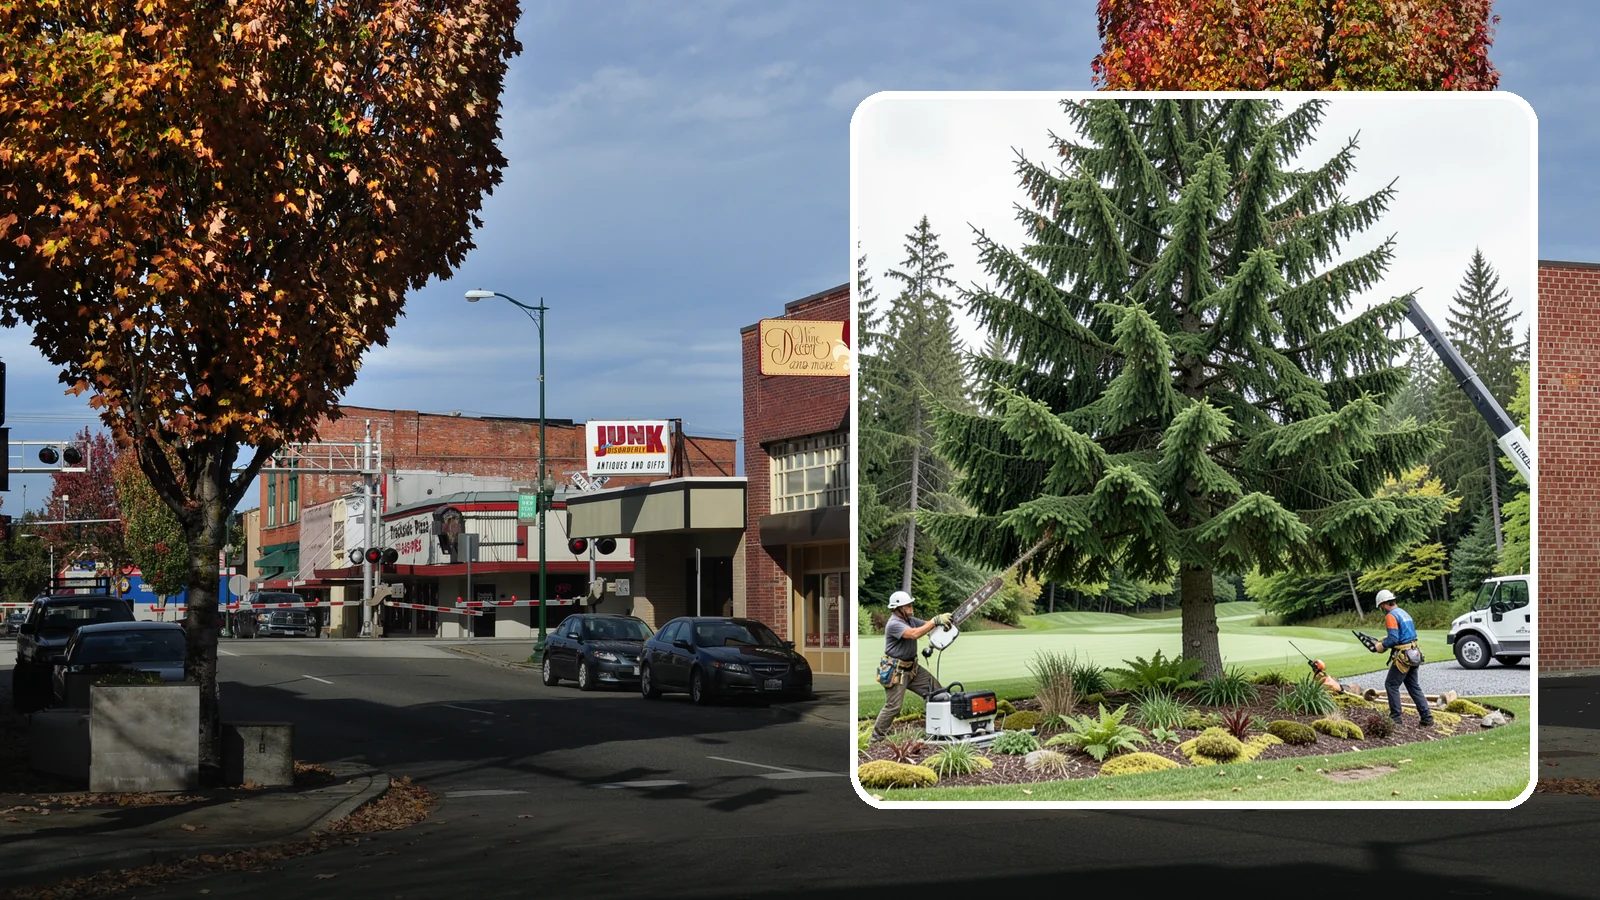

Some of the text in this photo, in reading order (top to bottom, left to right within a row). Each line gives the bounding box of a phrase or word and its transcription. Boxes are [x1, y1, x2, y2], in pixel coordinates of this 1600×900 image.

[595, 425, 665, 457] JUNK
[597, 460, 665, 470] ANTIQUES AND GIFTS
[391, 520, 429, 539] Trackside Pizza
